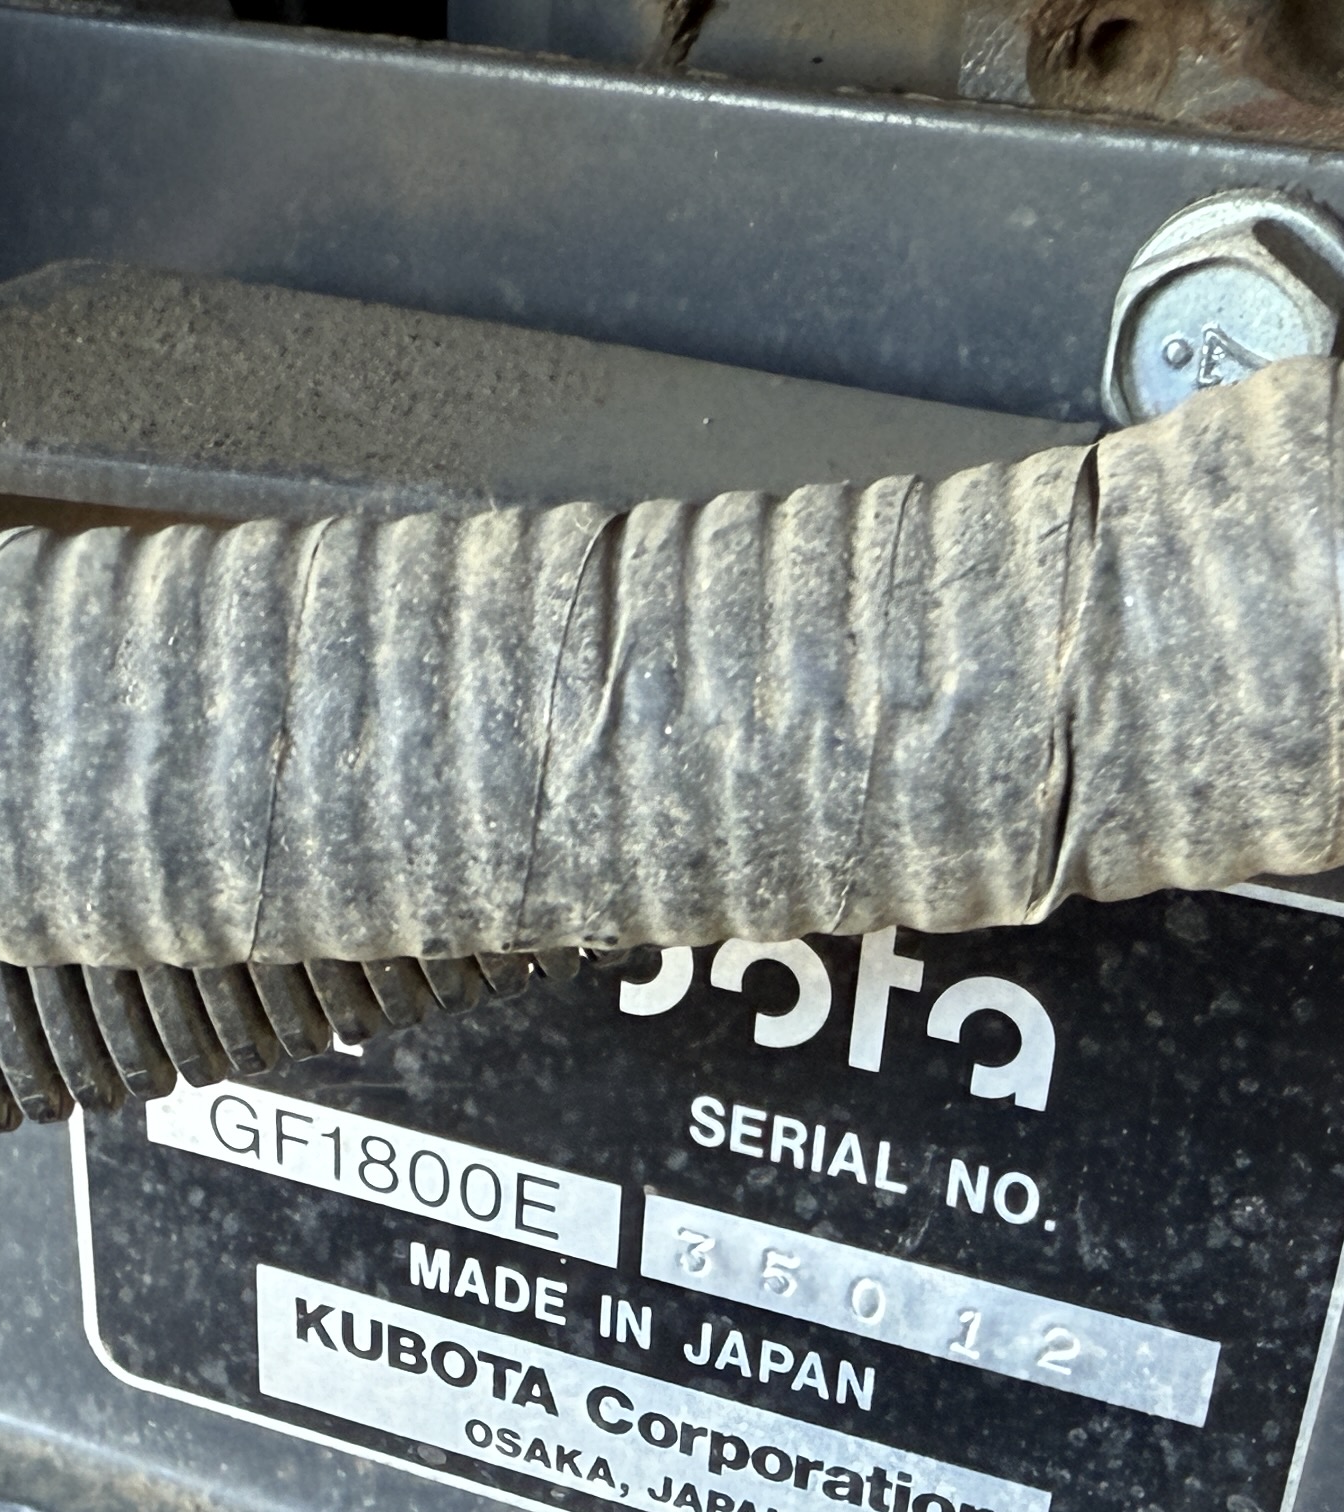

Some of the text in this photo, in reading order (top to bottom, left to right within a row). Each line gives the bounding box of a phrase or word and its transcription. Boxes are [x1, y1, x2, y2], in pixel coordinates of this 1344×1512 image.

[618, 926, 1057, 1112] ota
[210, 1094, 561, 1240] GF1800E
[689, 1095, 1057, 1232] SERIAL NO.
[295, 1296, 560, 1418] KUBOTA
[410, 1241, 876, 1412] MADE IN JAPAN
[465, 1417, 630, 1500] OSAKA,
